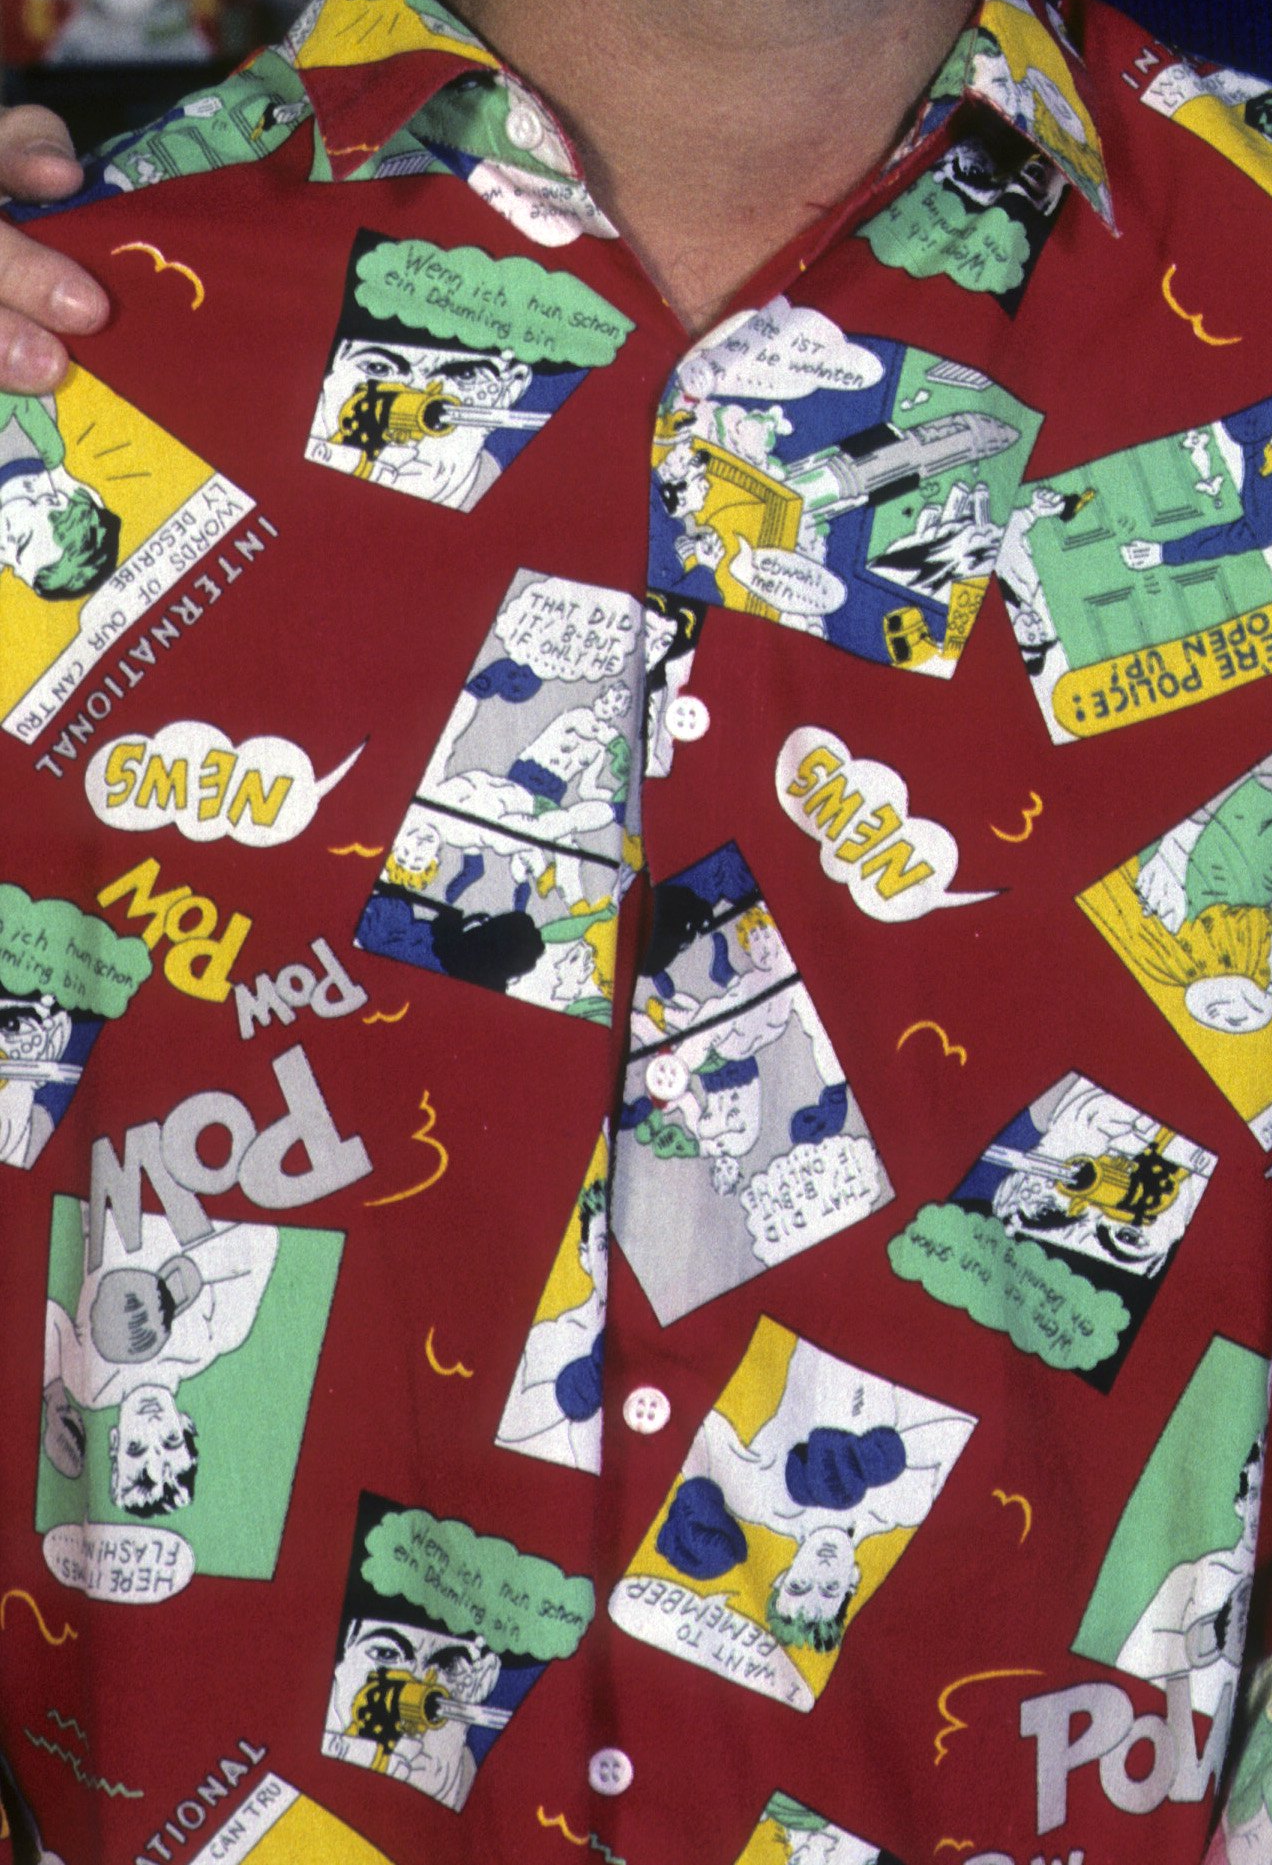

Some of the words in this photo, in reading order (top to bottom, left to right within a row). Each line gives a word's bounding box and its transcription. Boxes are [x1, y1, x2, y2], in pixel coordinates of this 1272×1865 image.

[384, 270, 417, 296] ein
[404, 245, 463, 291] Wenn
[109, 513, 200, 594] DESCRIBE
[169, 500, 245, 574] WORDS
[139, 579, 164, 607] OF
[531, 592, 581, 620] THAT
[588, 605, 633, 633] DID
[34, 515, 281, 779] INTERNATIONAL
[86, 609, 127, 653] OUR
[1181, 611, 1270, 663] OPEN
[50, 661, 86, 700] CAN
[105, 741, 294, 829] NEWS
[788, 746, 936, 901] NEWS
[97, 857, 253, 1003] POW
[234, 937, 370, 1040] POW
[87, 1043, 374, 1273] POW
[108, 1567, 175, 1594] HERE
[626, 1581, 780, 1658] REMEMBER
[676, 1622, 701, 1649] TO
[712, 1644, 776, 1681] WANT
[210, 1819, 247, 1859] CAN
[242, 1781, 282, 1818] TRU
